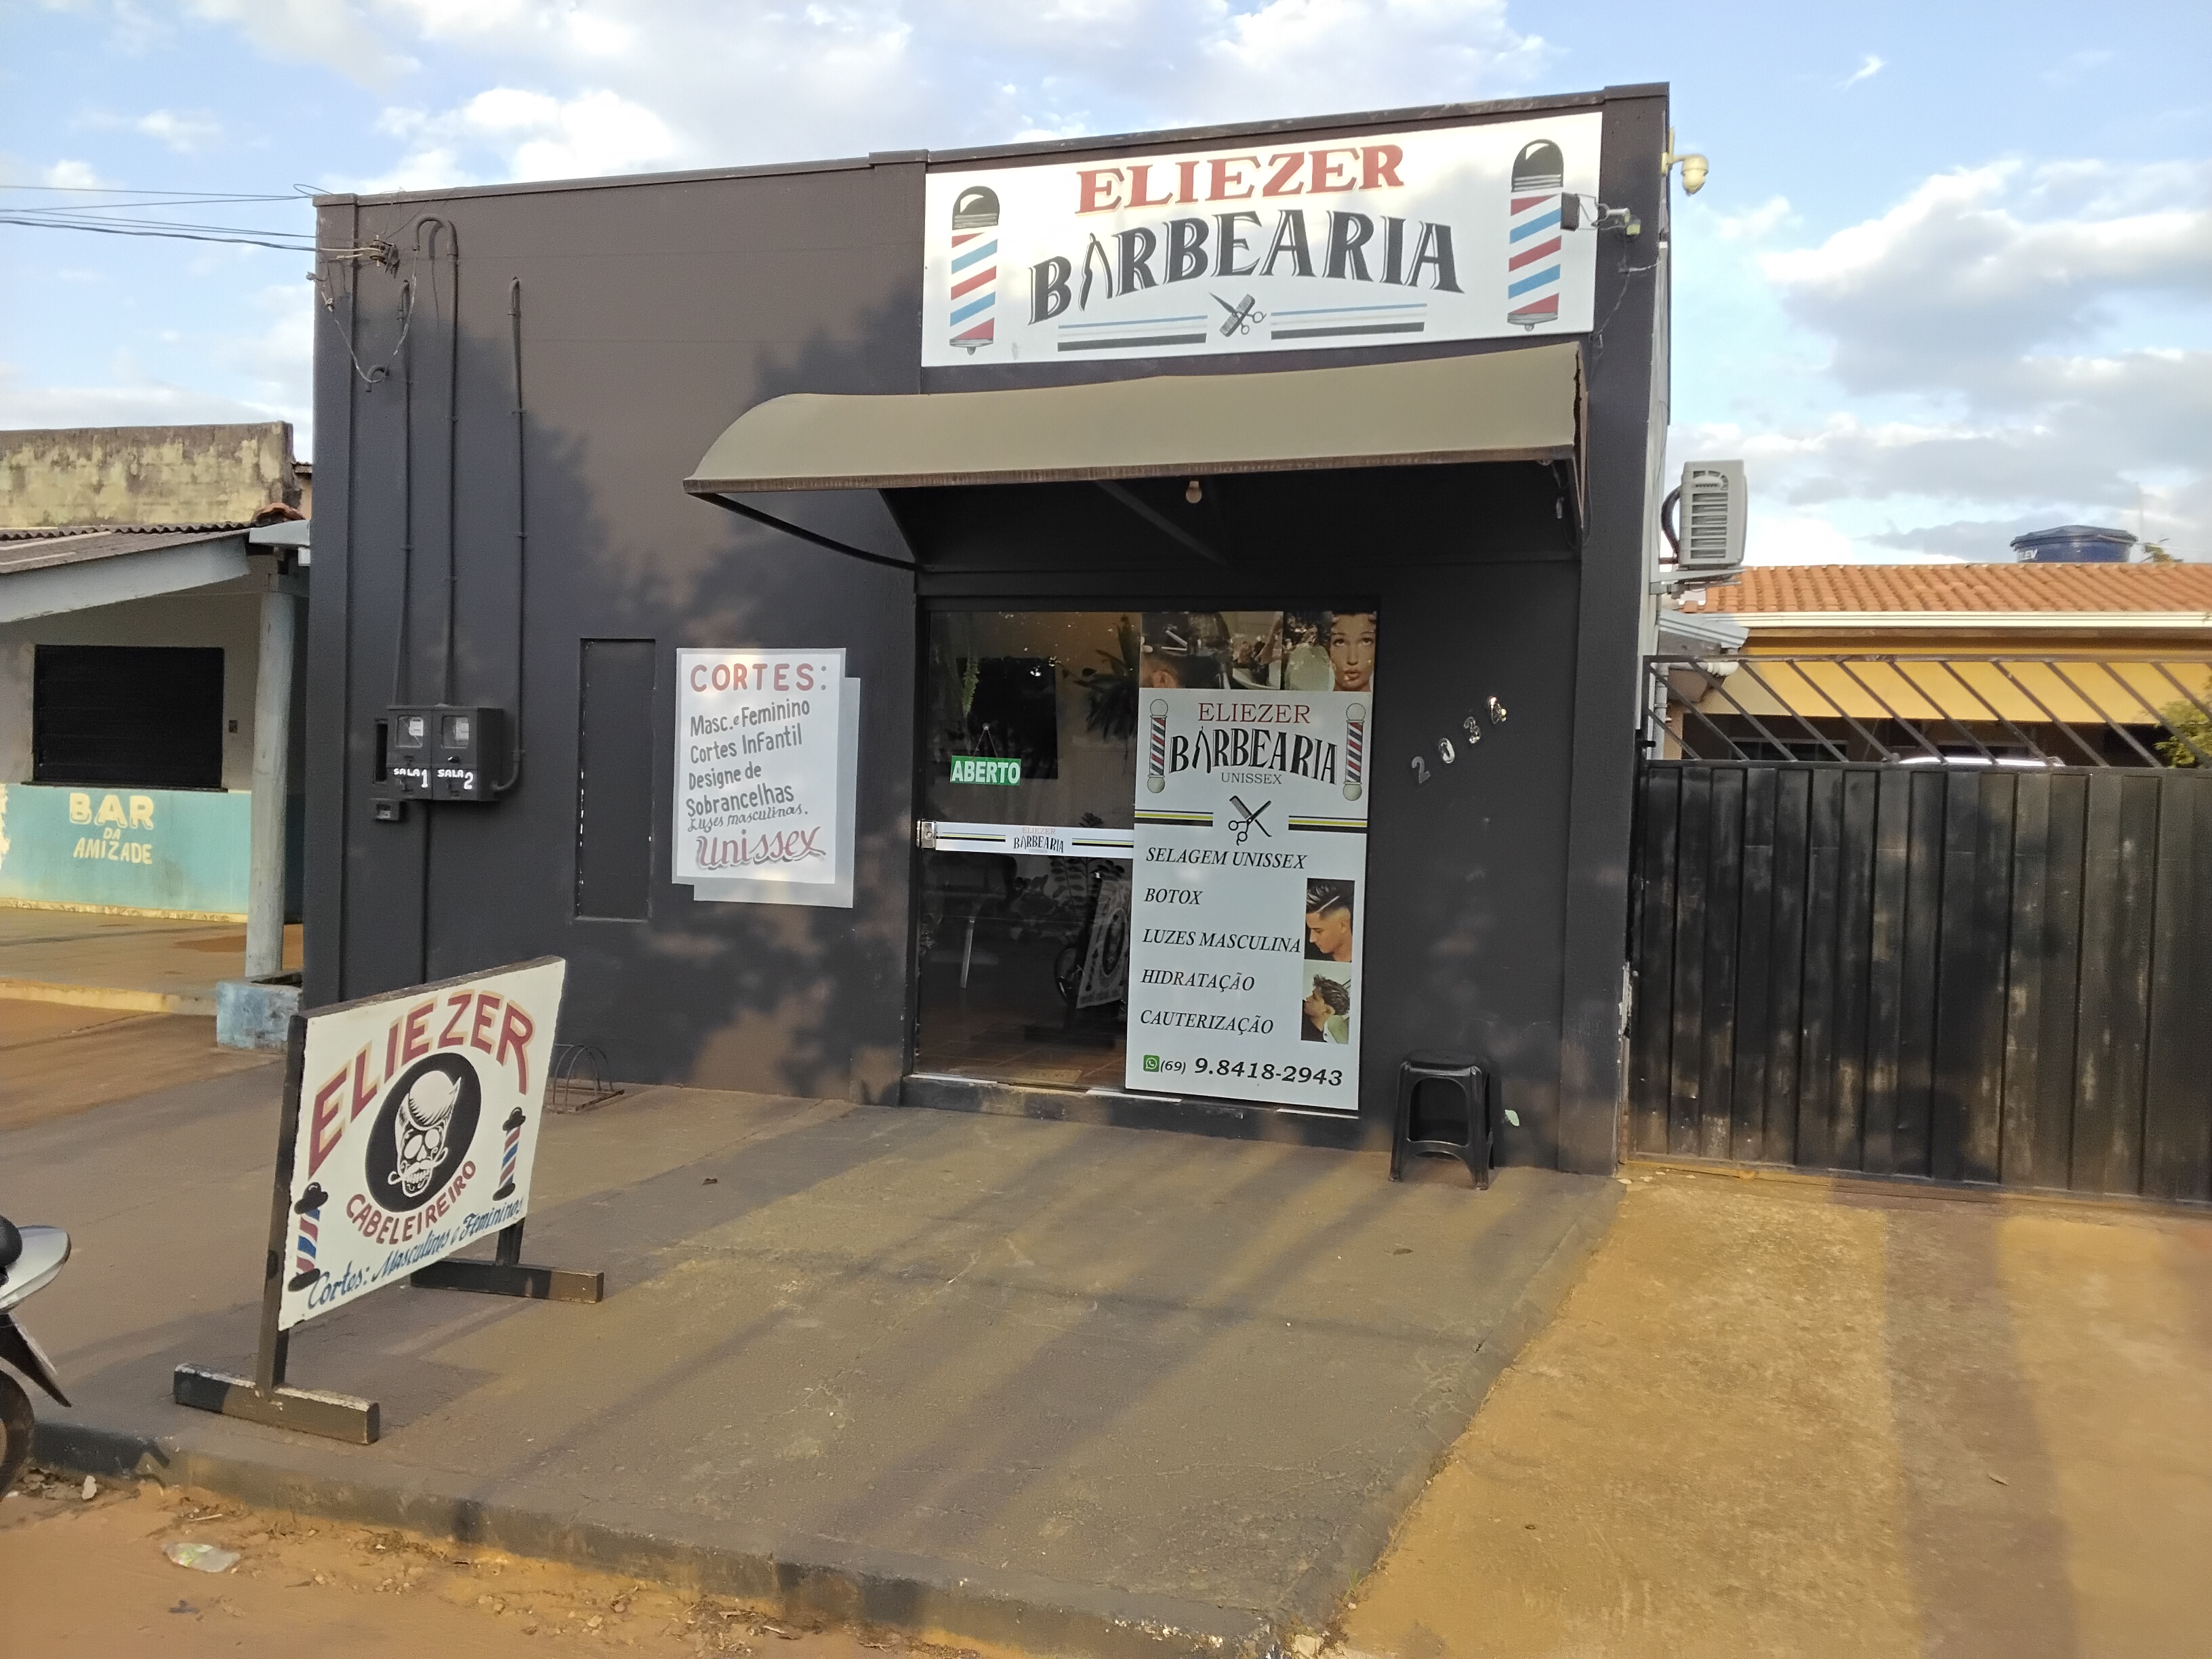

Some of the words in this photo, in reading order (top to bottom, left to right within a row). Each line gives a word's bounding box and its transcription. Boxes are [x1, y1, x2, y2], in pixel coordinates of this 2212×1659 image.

[1076, 144, 1404, 216] ELIEZER
[1027, 208, 1466, 326] BARBEARIA
[690, 663, 827, 692] CORTES:
[690, 715, 733, 737] Masc.
[741, 698, 810, 727] Feminino
[1197, 702, 1311, 724] ELIEZER
[691, 741, 737, 764] Cortes
[1169, 726, 1338, 785] BARBEARIA
[394, 768, 419, 777] SALA
[422, 769, 428, 788] 1
[437, 769, 464, 778] SALA
[464, 772, 474, 790] 2
[689, 767, 741, 790] Designe
[745, 761, 761, 779] de
[951, 761, 1021, 783] ABERTO
[1221, 773, 1282, 785] UNISSEX
[69, 792, 155, 831] BAR
[686, 783, 794, 817] Sobrancelhas
[103, 827, 121, 840] DA
[1014, 835, 1063, 853] BARBEARIA
[73, 838, 152, 864] AMIZADE
[1146, 847, 1229, 866] SELAGEM
[1232, 851, 1308, 869] UNISSEX
[1143, 888, 1204, 905] BOTOX
[1142, 928, 1195, 946] LUZES
[1199, 932, 1300, 954] MASCULINA
[1140, 968, 1255, 993] HIDRATAÇÃO
[1140, 1010, 1274, 1035] CAUTERIZAÇÃO
[308, 989, 535, 1180] ELIEZER
[1160, 1060, 1186, 1074] (69)
[1194, 1057, 1343, 1086] 9.8418-2943
[346, 1160, 476, 1245] CABELEIREIRO
[371, 1229, 451, 1282] Masculinos
